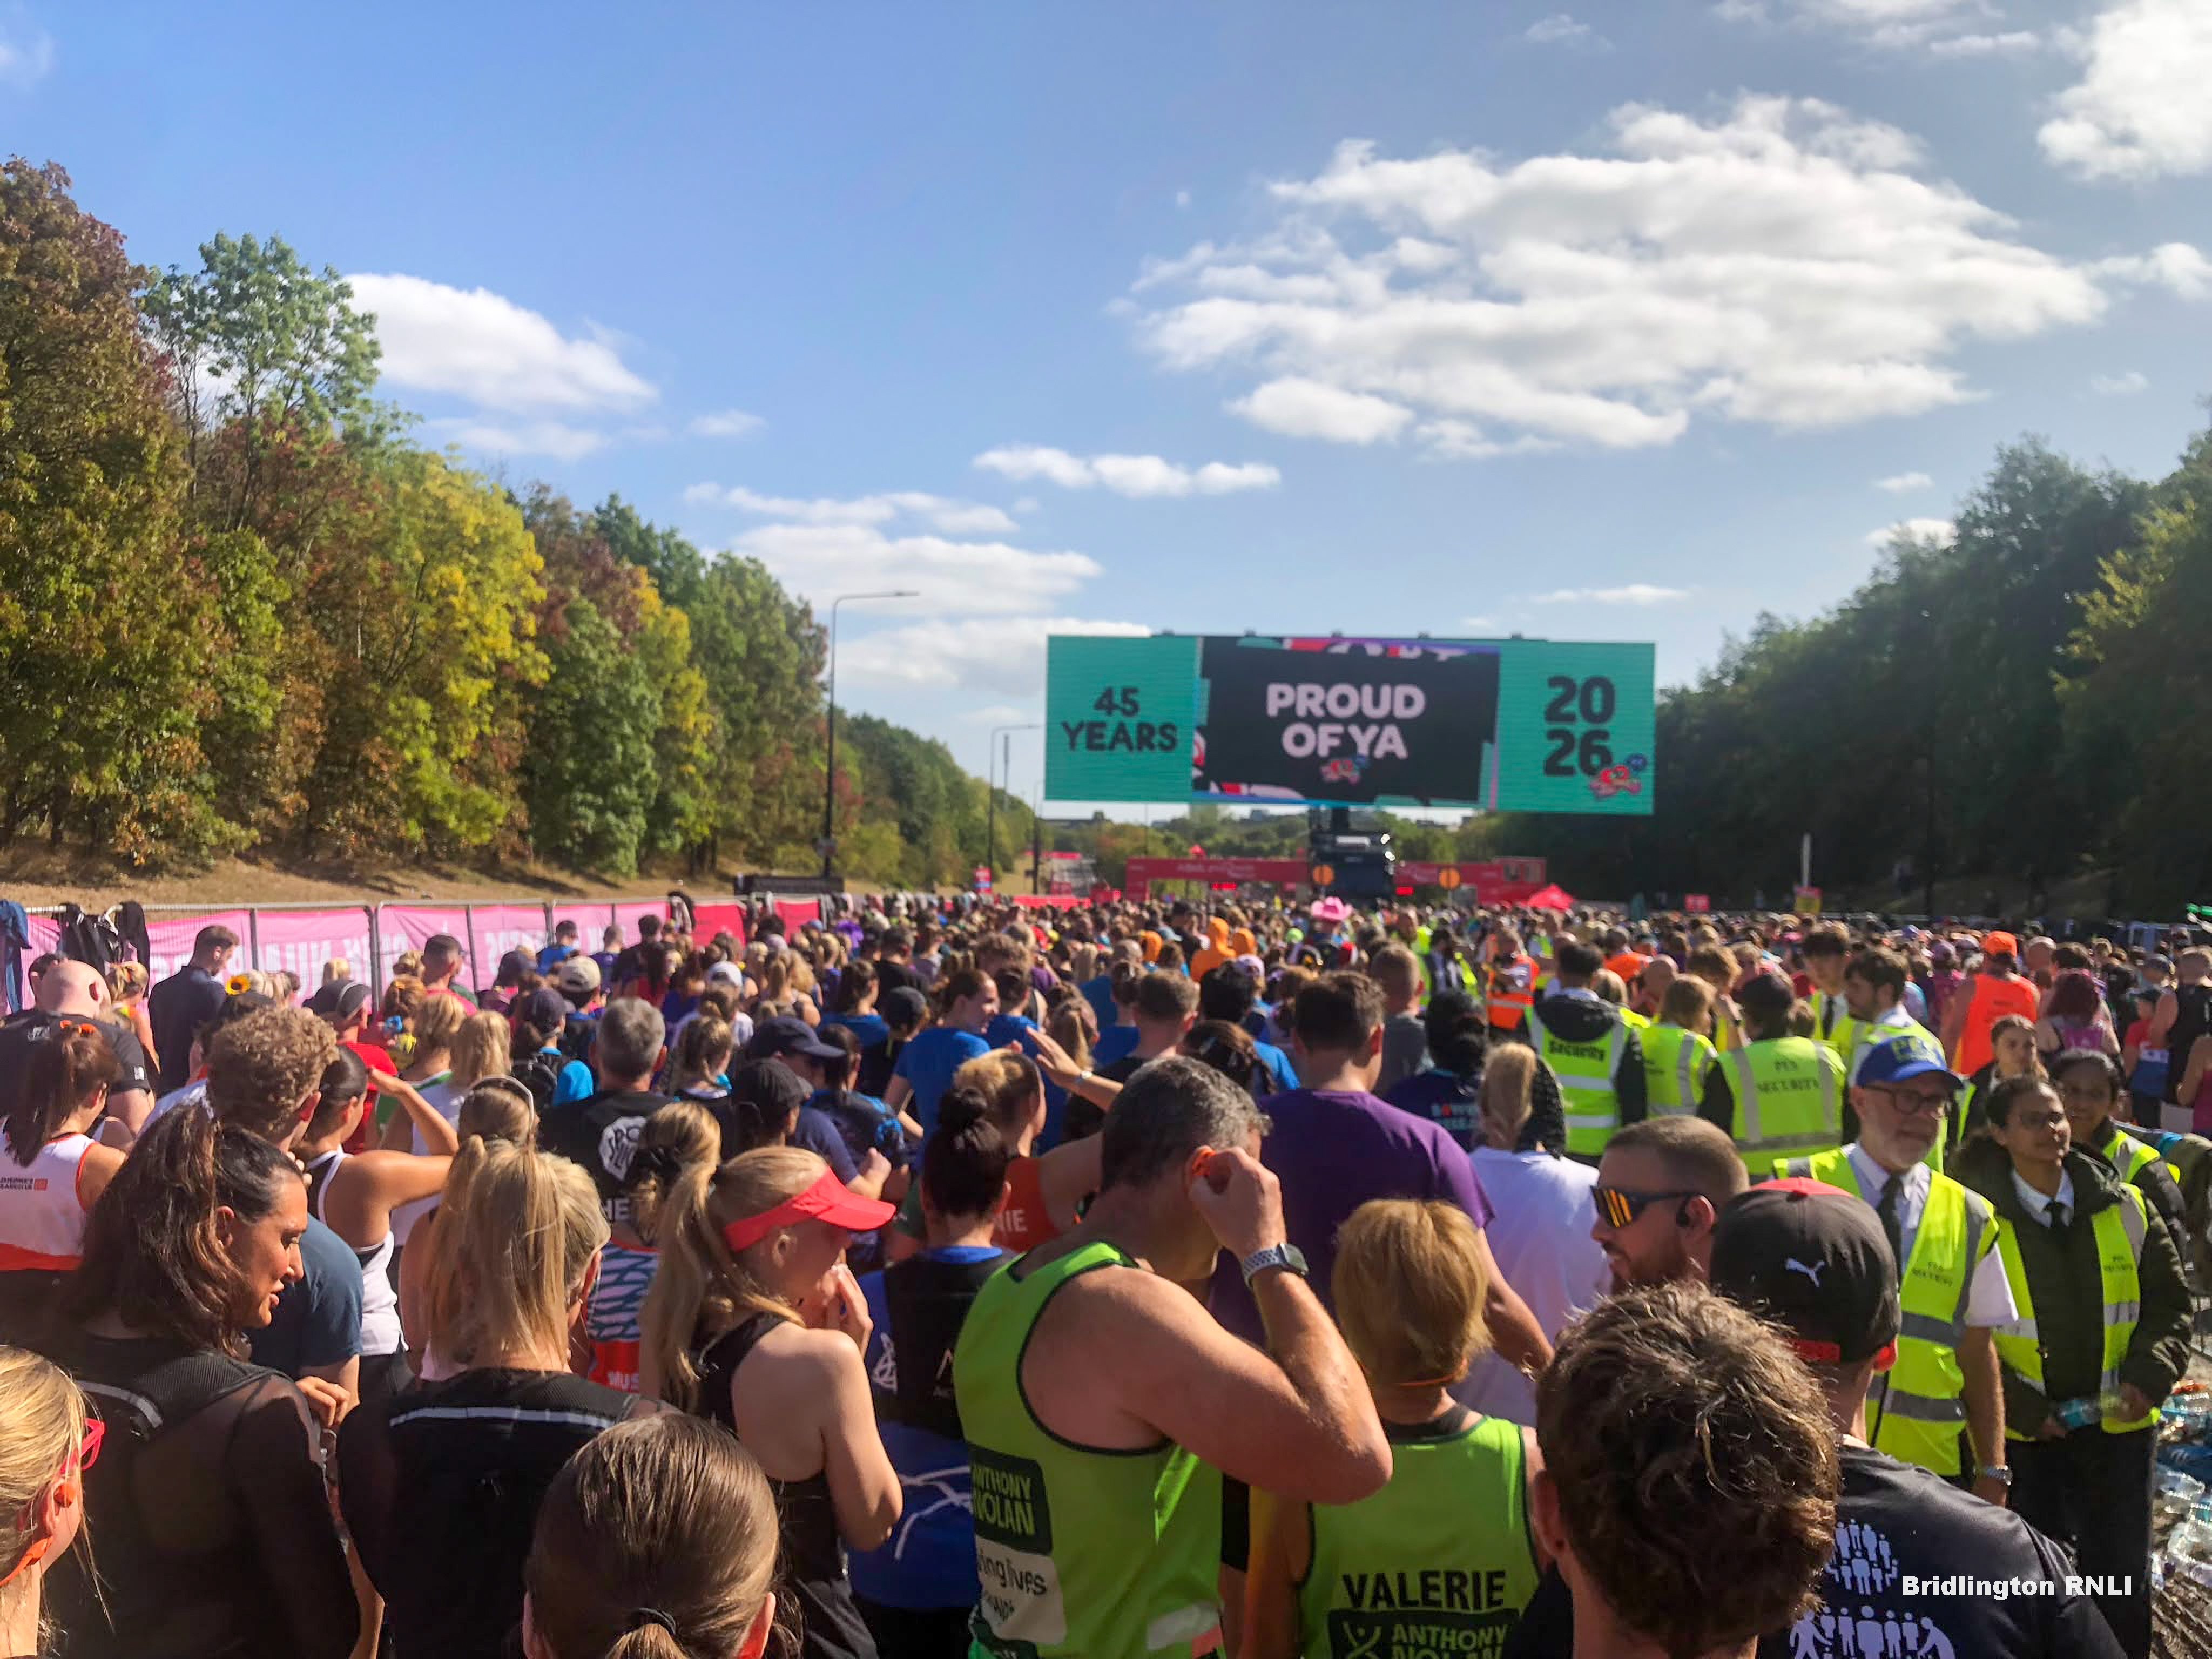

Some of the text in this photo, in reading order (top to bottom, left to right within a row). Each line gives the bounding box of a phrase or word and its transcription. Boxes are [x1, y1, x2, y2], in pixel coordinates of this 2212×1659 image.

[1094, 686, 1139, 717] 45
[1267, 683, 1426, 719] PROUD
[1545, 675, 1615, 724] 20
[1061, 720, 1177, 752] YEARS
[1282, 723, 1408, 759] OF YA
[1544, 729, 1612, 777] 26
[1342, 1570, 1506, 1609] VALERIE
[1391, 1623, 1507, 1650] ANTHONY
